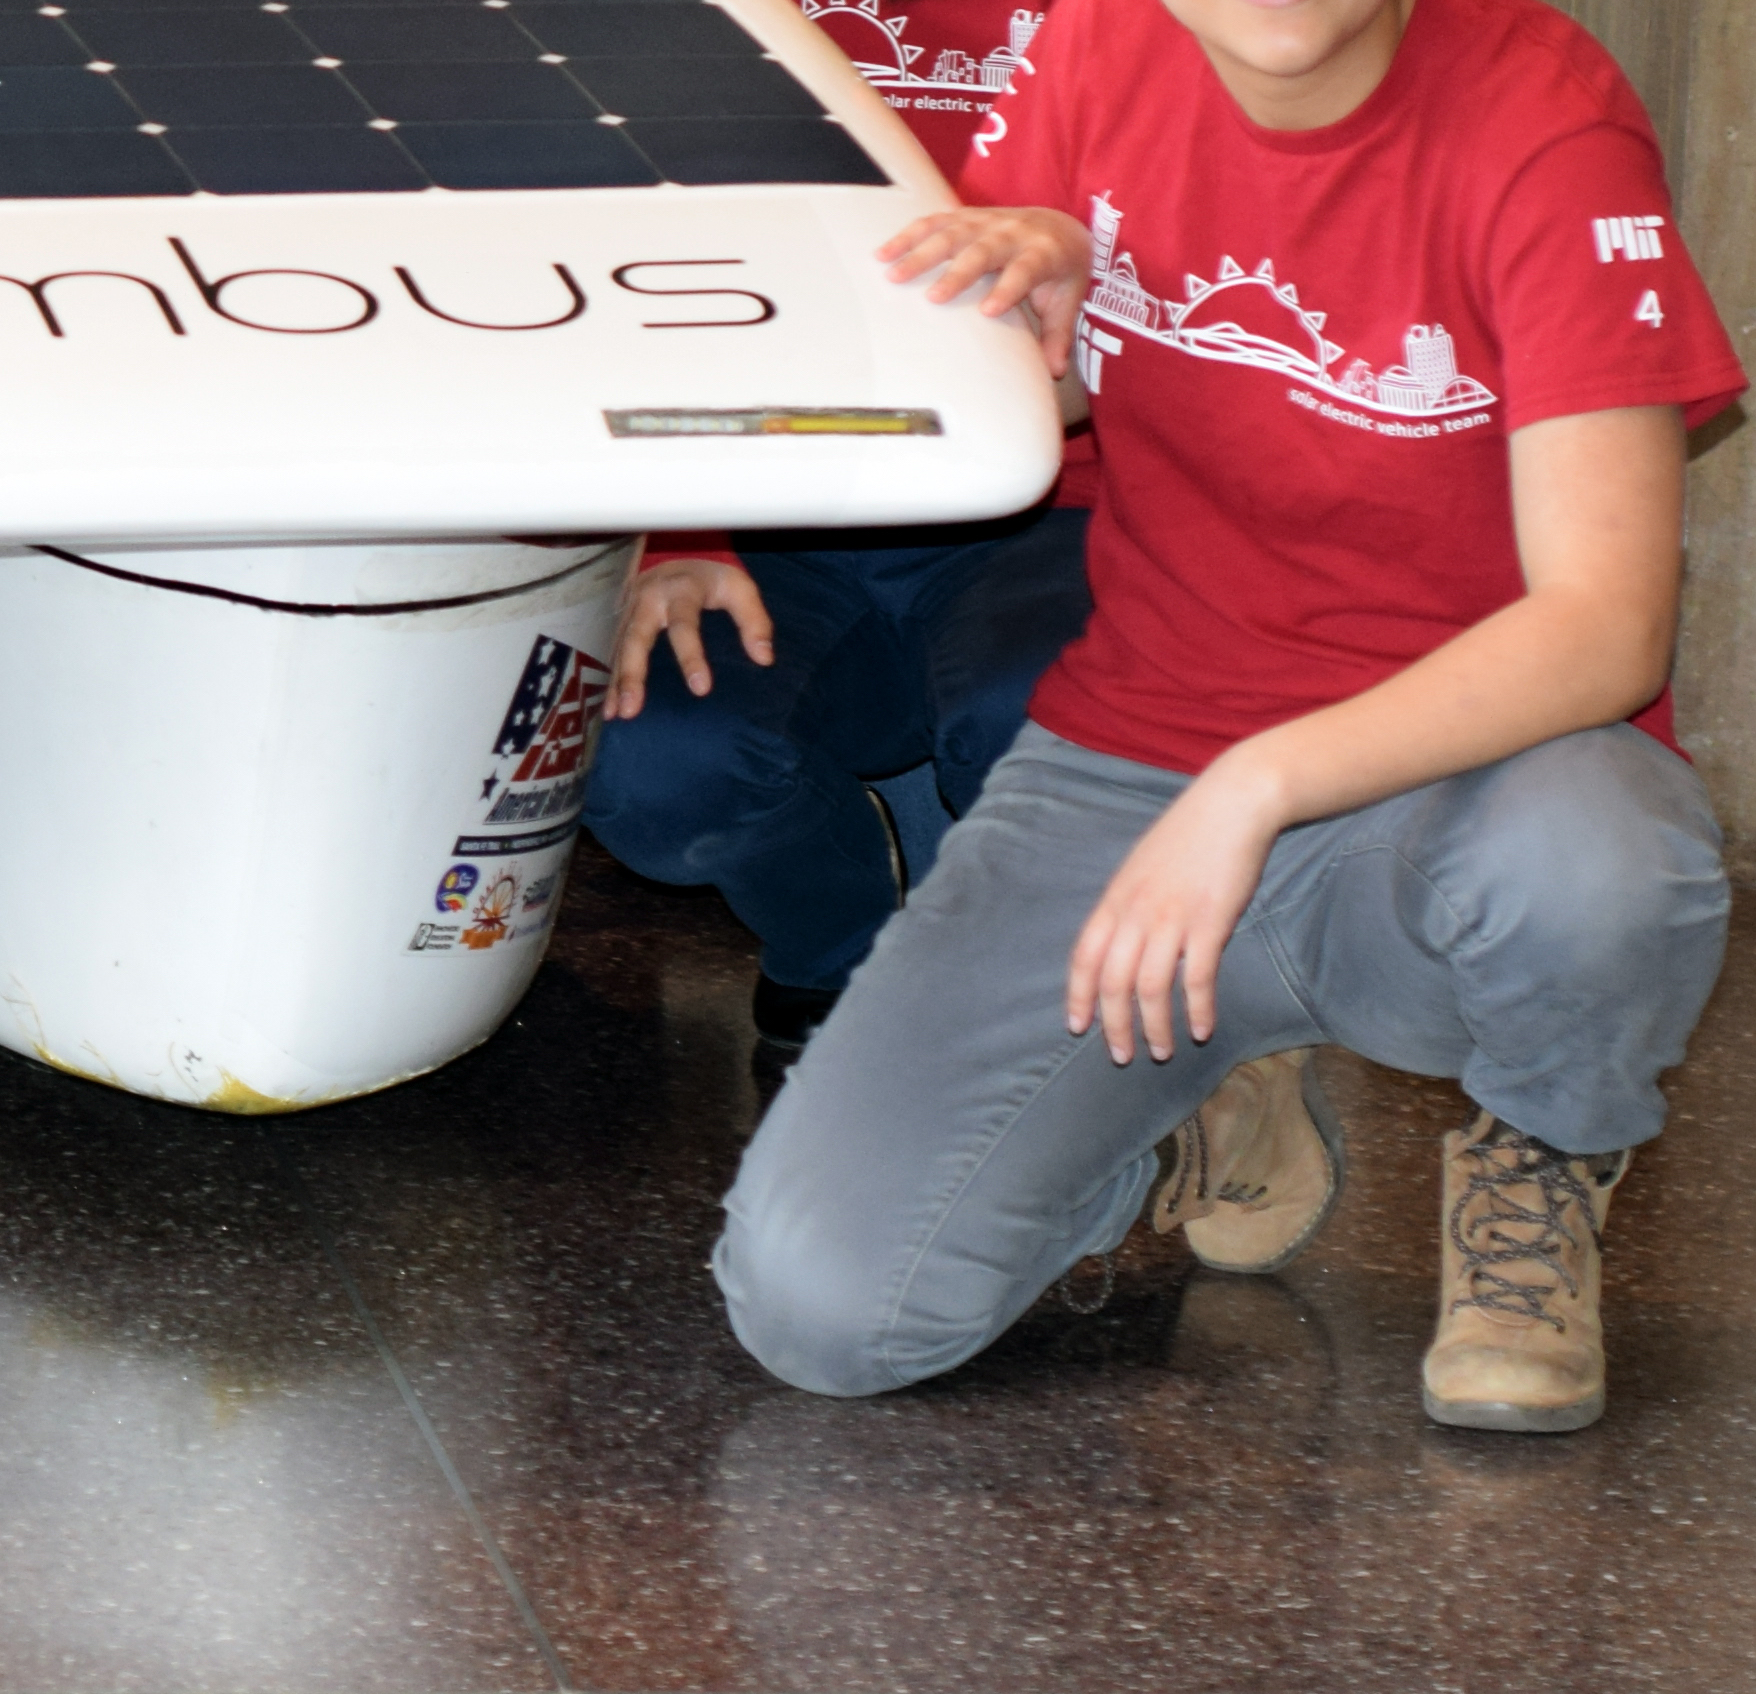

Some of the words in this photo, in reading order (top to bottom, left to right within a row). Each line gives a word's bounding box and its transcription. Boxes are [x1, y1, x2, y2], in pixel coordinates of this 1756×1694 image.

[914, 95, 973, 113] electric
[1634, 288, 1665, 329] 4
[1288, 387, 1320, 411] solar
[1319, 402, 1375, 431] electric
[1376, 420, 1440, 438] vehicle
[1441, 412, 1492, 434] team
